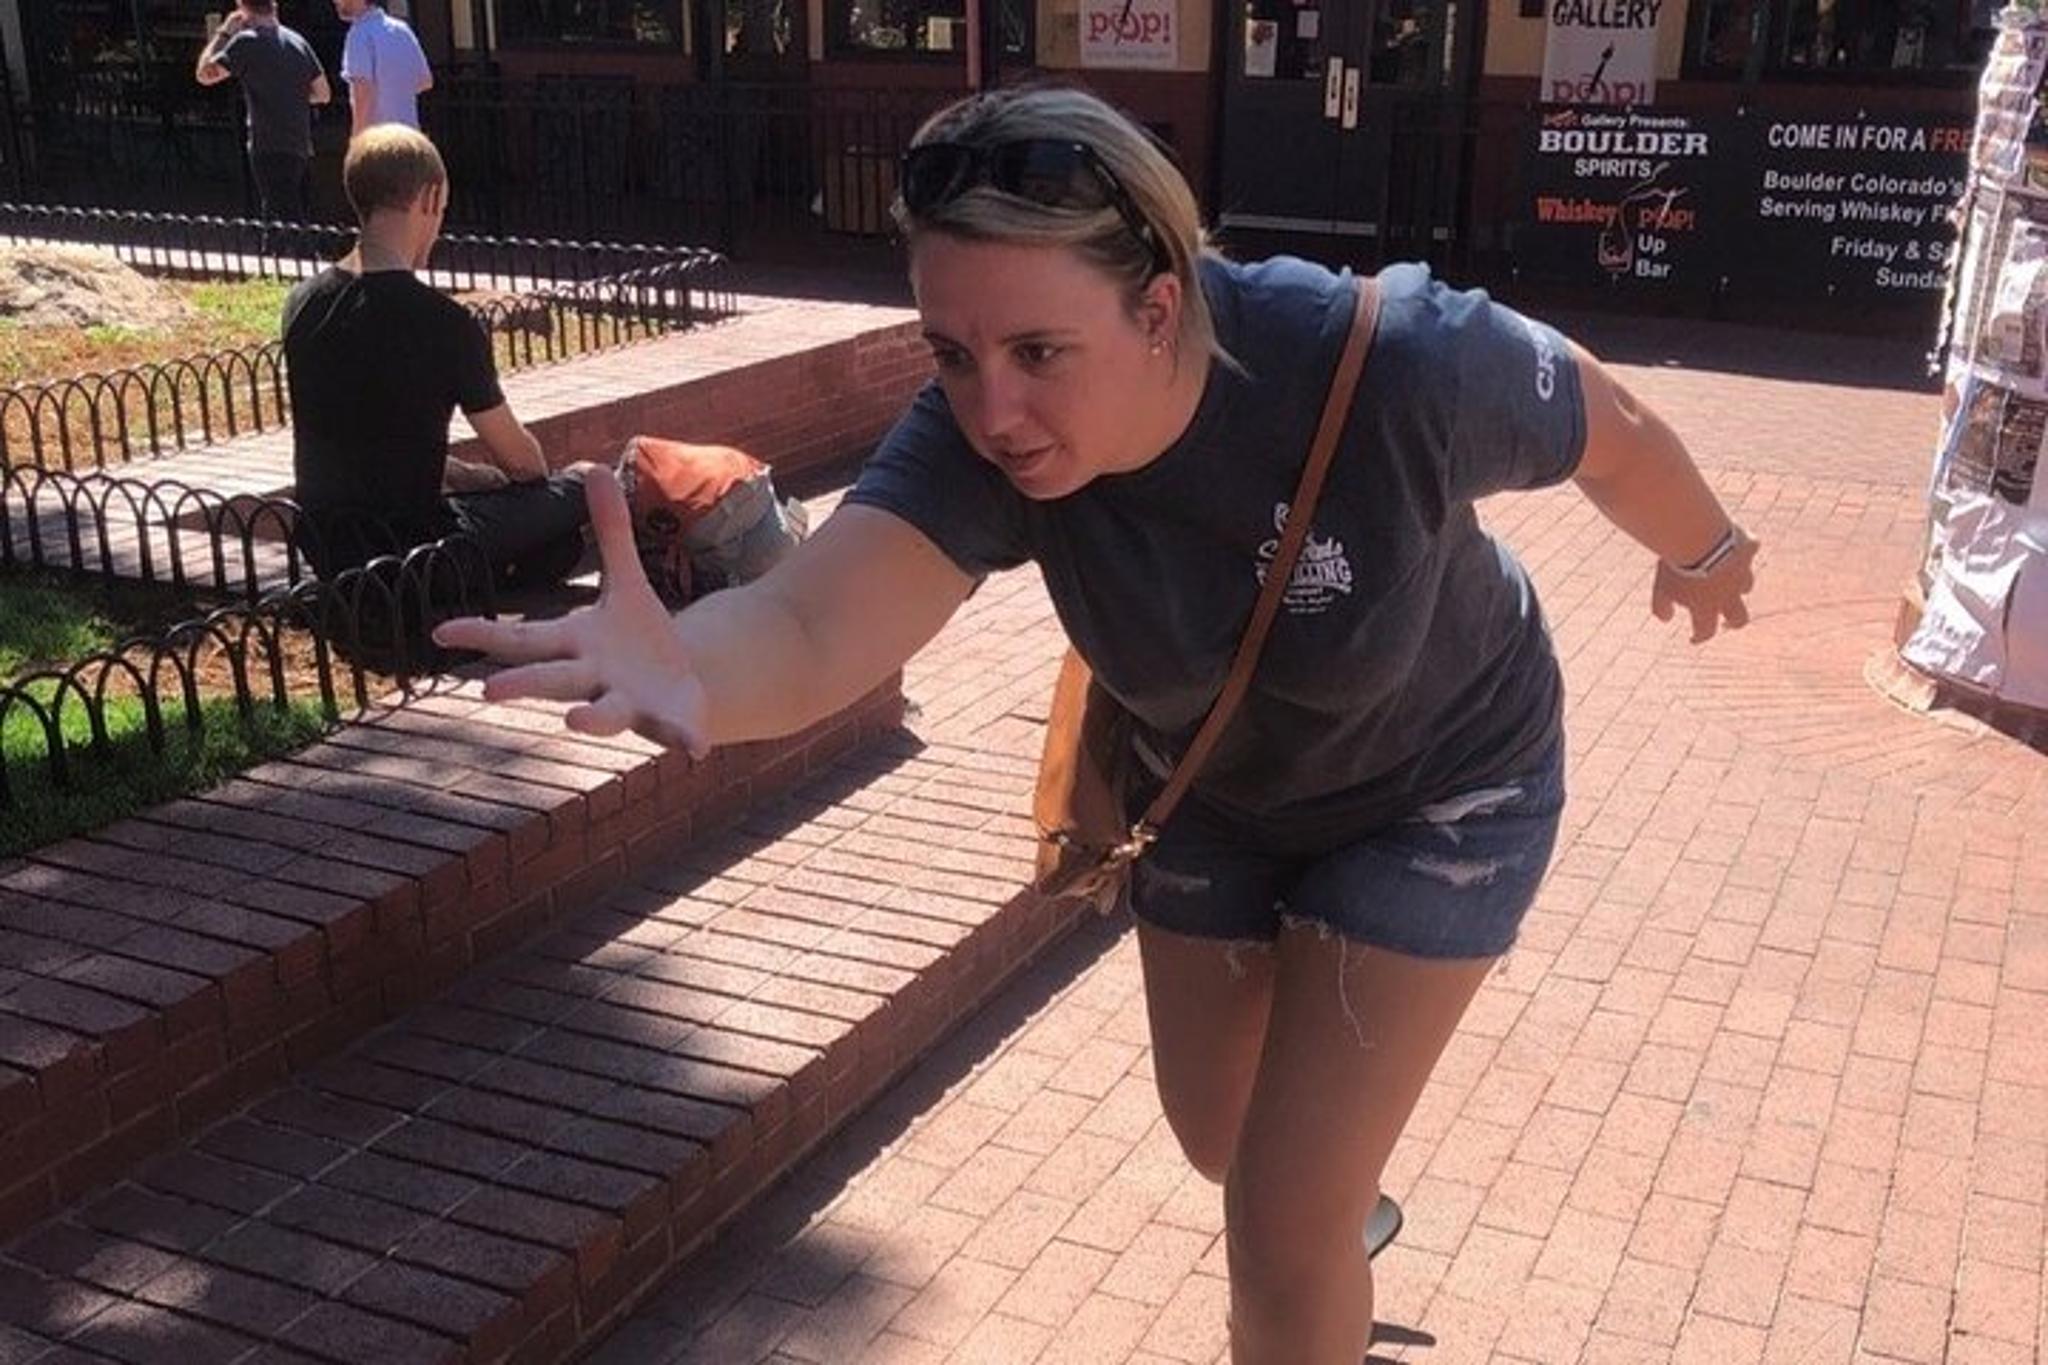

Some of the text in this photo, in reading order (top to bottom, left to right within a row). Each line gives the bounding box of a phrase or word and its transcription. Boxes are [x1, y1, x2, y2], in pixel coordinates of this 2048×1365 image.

[1552, 0, 1662, 29] GALLERY
[1581, 113, 1626, 128] Gallery
[1538, 129, 1709, 155] BOULDER
[1768, 124, 1831, 149] COME
[1834, 124, 1859, 149] IN
[1861, 126, 1907, 151] FOR
[1911, 127, 1927, 150] A
[1574, 157, 1652, 178] SPIRITS
[1763, 170, 1964, 195] Boulder Colorado's
[1537, 198, 1617, 228] Whiskey
[1759, 196, 1836, 222] Serving
[1841, 200, 1927, 227] Whiskey
[1637, 233, 1667, 256] Up
[1831, 236, 1899, 264] Friday
[1905, 240, 1921, 260] &
[1635, 258, 1671, 278] Bar
